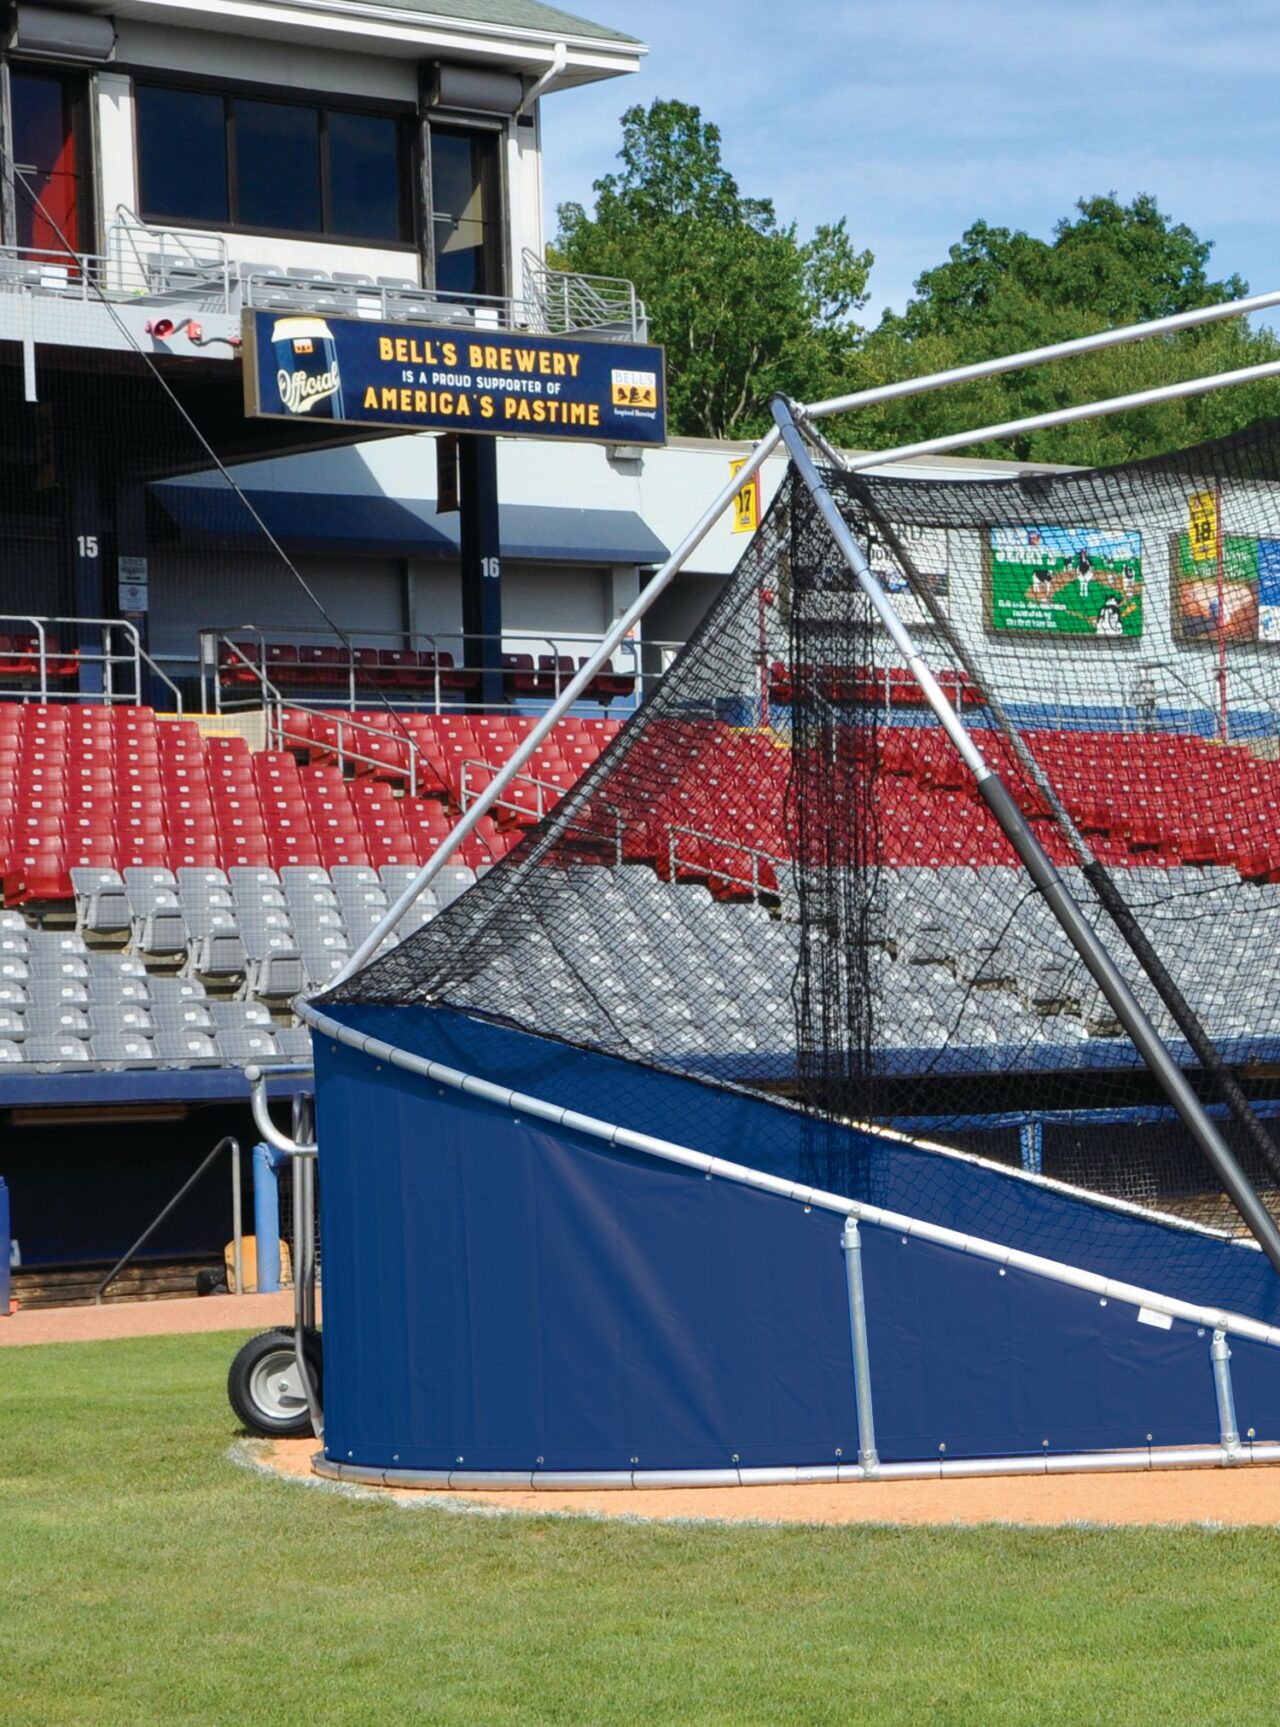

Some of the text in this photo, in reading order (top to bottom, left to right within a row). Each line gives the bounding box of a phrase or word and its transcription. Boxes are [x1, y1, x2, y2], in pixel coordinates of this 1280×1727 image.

[378, 336, 581, 377] BELL'S BREWERY
[276, 360, 340, 413] Official
[401, 370, 562, 396] IS A PROUD SUPPORTER OF
[363, 386, 601, 427] AMERICA'S PASTIME
[1193, 520, 1212, 544] 18
[77, 535, 99, 559] 15
[480, 557, 501, 579] 16
